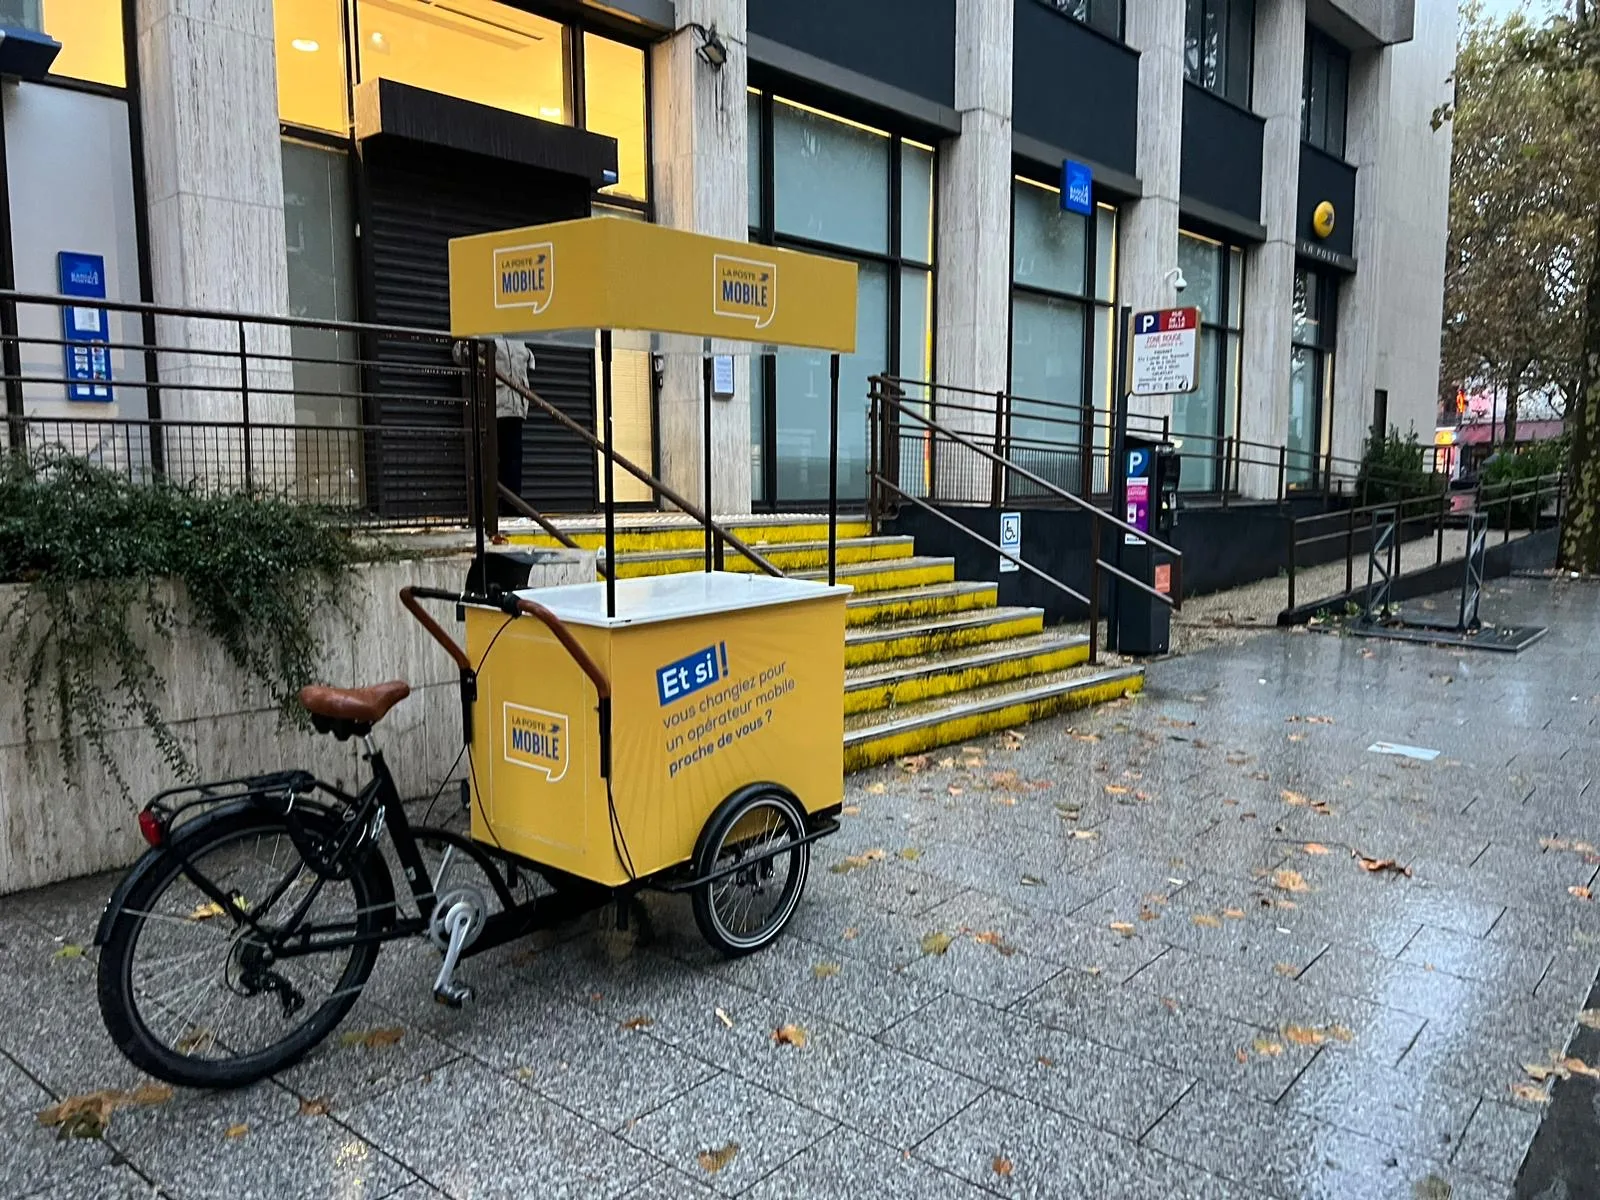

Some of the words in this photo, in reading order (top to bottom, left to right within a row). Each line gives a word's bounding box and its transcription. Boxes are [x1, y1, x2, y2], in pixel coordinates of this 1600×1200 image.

[501, 260, 511, 269] LA
[512, 257, 533, 267] POSTE
[722, 267, 732, 276] LA
[733, 269, 756, 281] POSTE
[1142, 315, 1155, 333] P
[1129, 451, 1143, 474] P
[662, 666, 690, 699] Et
[695, 653, 713, 684] si
[719, 640, 729, 678] !
[663, 705, 697, 729] vous
[699, 676, 756, 713] changiez
[759, 661, 787, 687] pour
[511, 715, 521, 726] LA
[522, 718, 546, 731] POSTE
[666, 735, 684, 752] un
[687, 699, 752, 741] opérateur
[755, 677, 795, 707] mobile
[668, 742, 714, 778] proche
[717, 731, 733, 749] de
[735, 716, 763, 739] vous
[765, 708, 773, 723] ?
